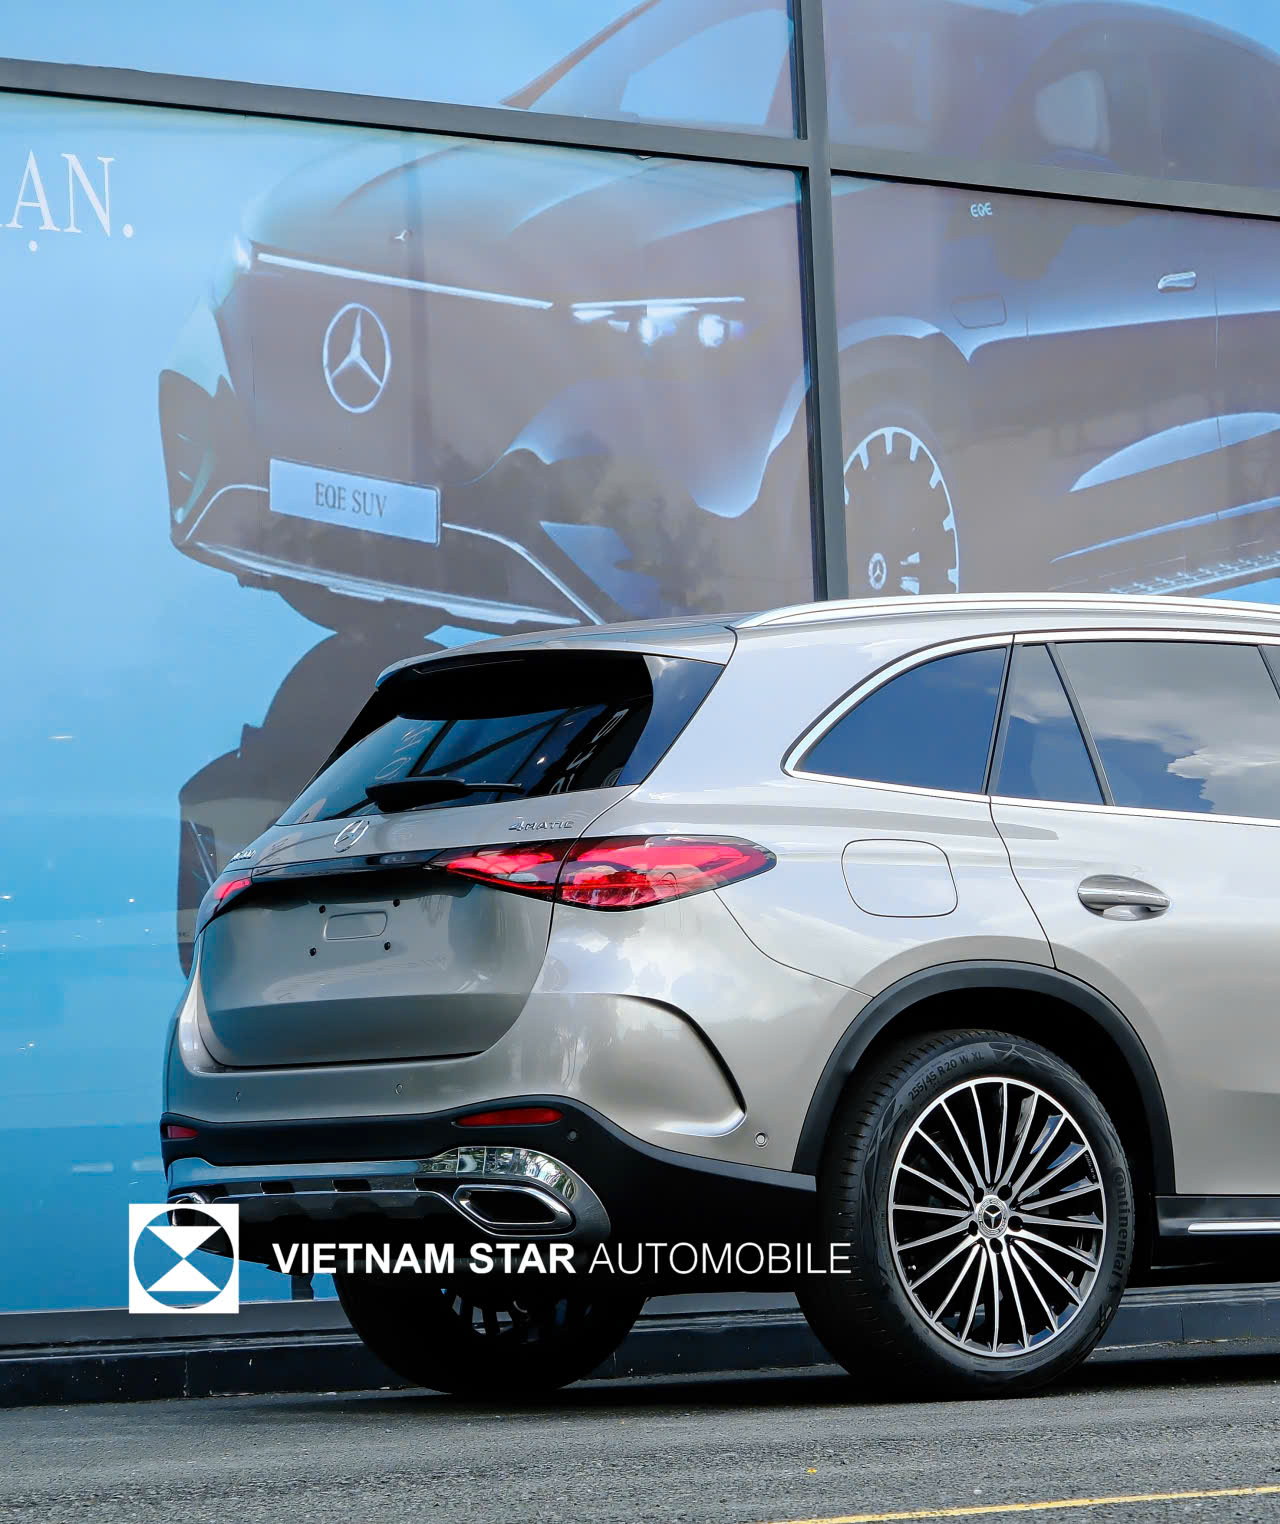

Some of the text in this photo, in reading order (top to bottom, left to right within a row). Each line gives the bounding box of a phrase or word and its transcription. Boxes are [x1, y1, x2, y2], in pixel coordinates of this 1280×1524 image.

[0, 149, 134, 252] ẠN.
[970, 202, 993, 217] EQE
[315, 482, 387, 518] EQE SUV
[507, 816, 575, 832] 4MATIC
[908, 1071, 937, 1101] 255/45
[971, 1051, 984, 1062] XL
[1112, 1167, 1130, 1278] Continental
